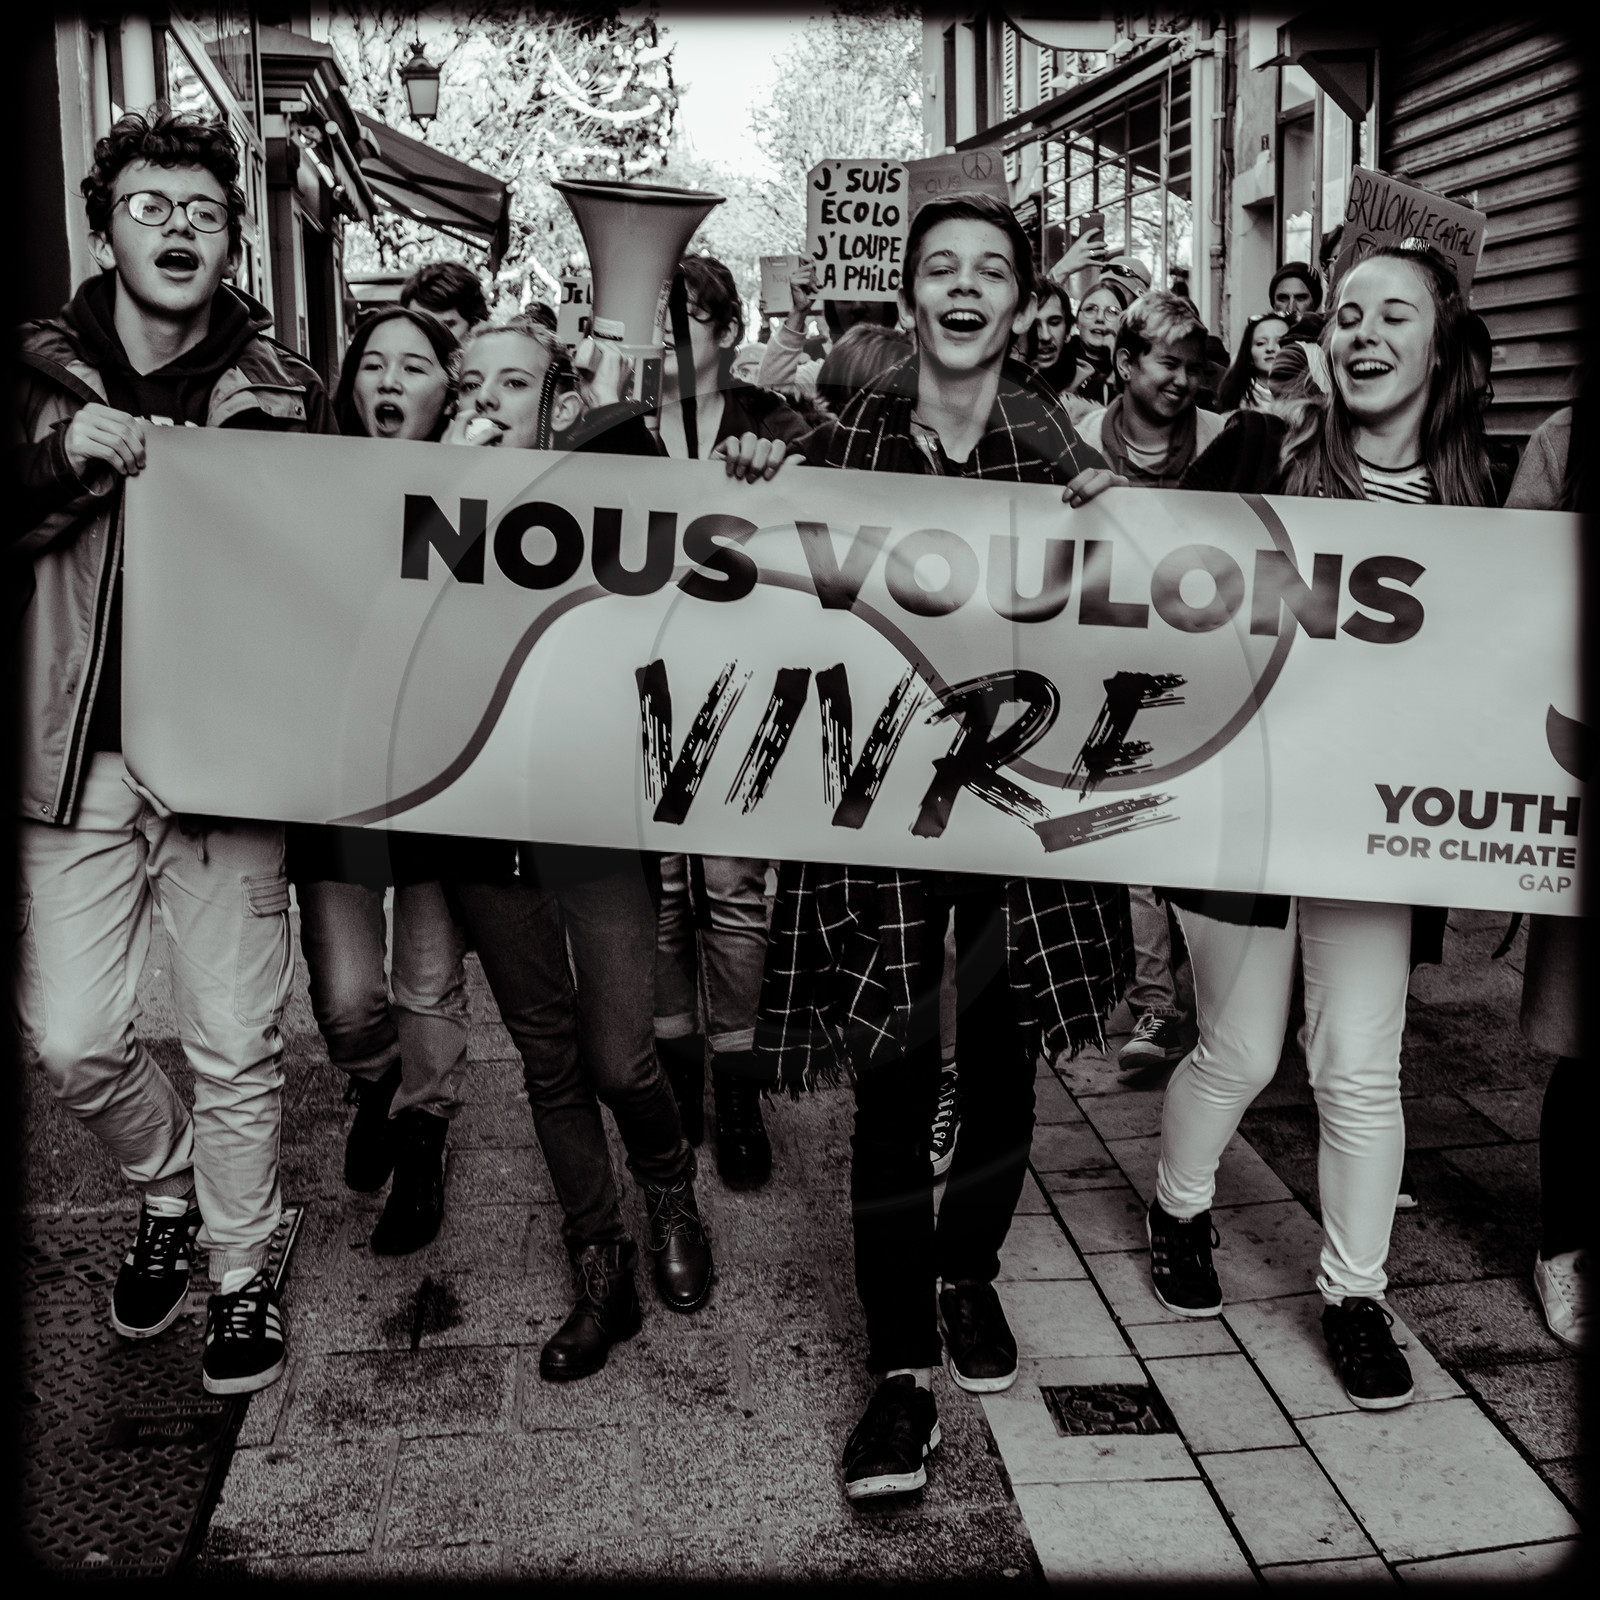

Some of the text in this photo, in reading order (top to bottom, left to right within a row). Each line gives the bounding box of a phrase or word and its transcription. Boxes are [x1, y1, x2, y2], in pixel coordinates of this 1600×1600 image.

[821, 191, 900, 227] ÉCOLO
[812, 231, 902, 263] J'LOUPE
[400, 493, 1427, 645] NOUS VOULONS
[635, 659, 1187, 852] VIVRE
[1375, 784, 1581, 837] YOUTH
[1367, 833, 1577, 869] FOR CLIMATE
[1518, 873, 1572, 893] GAP
